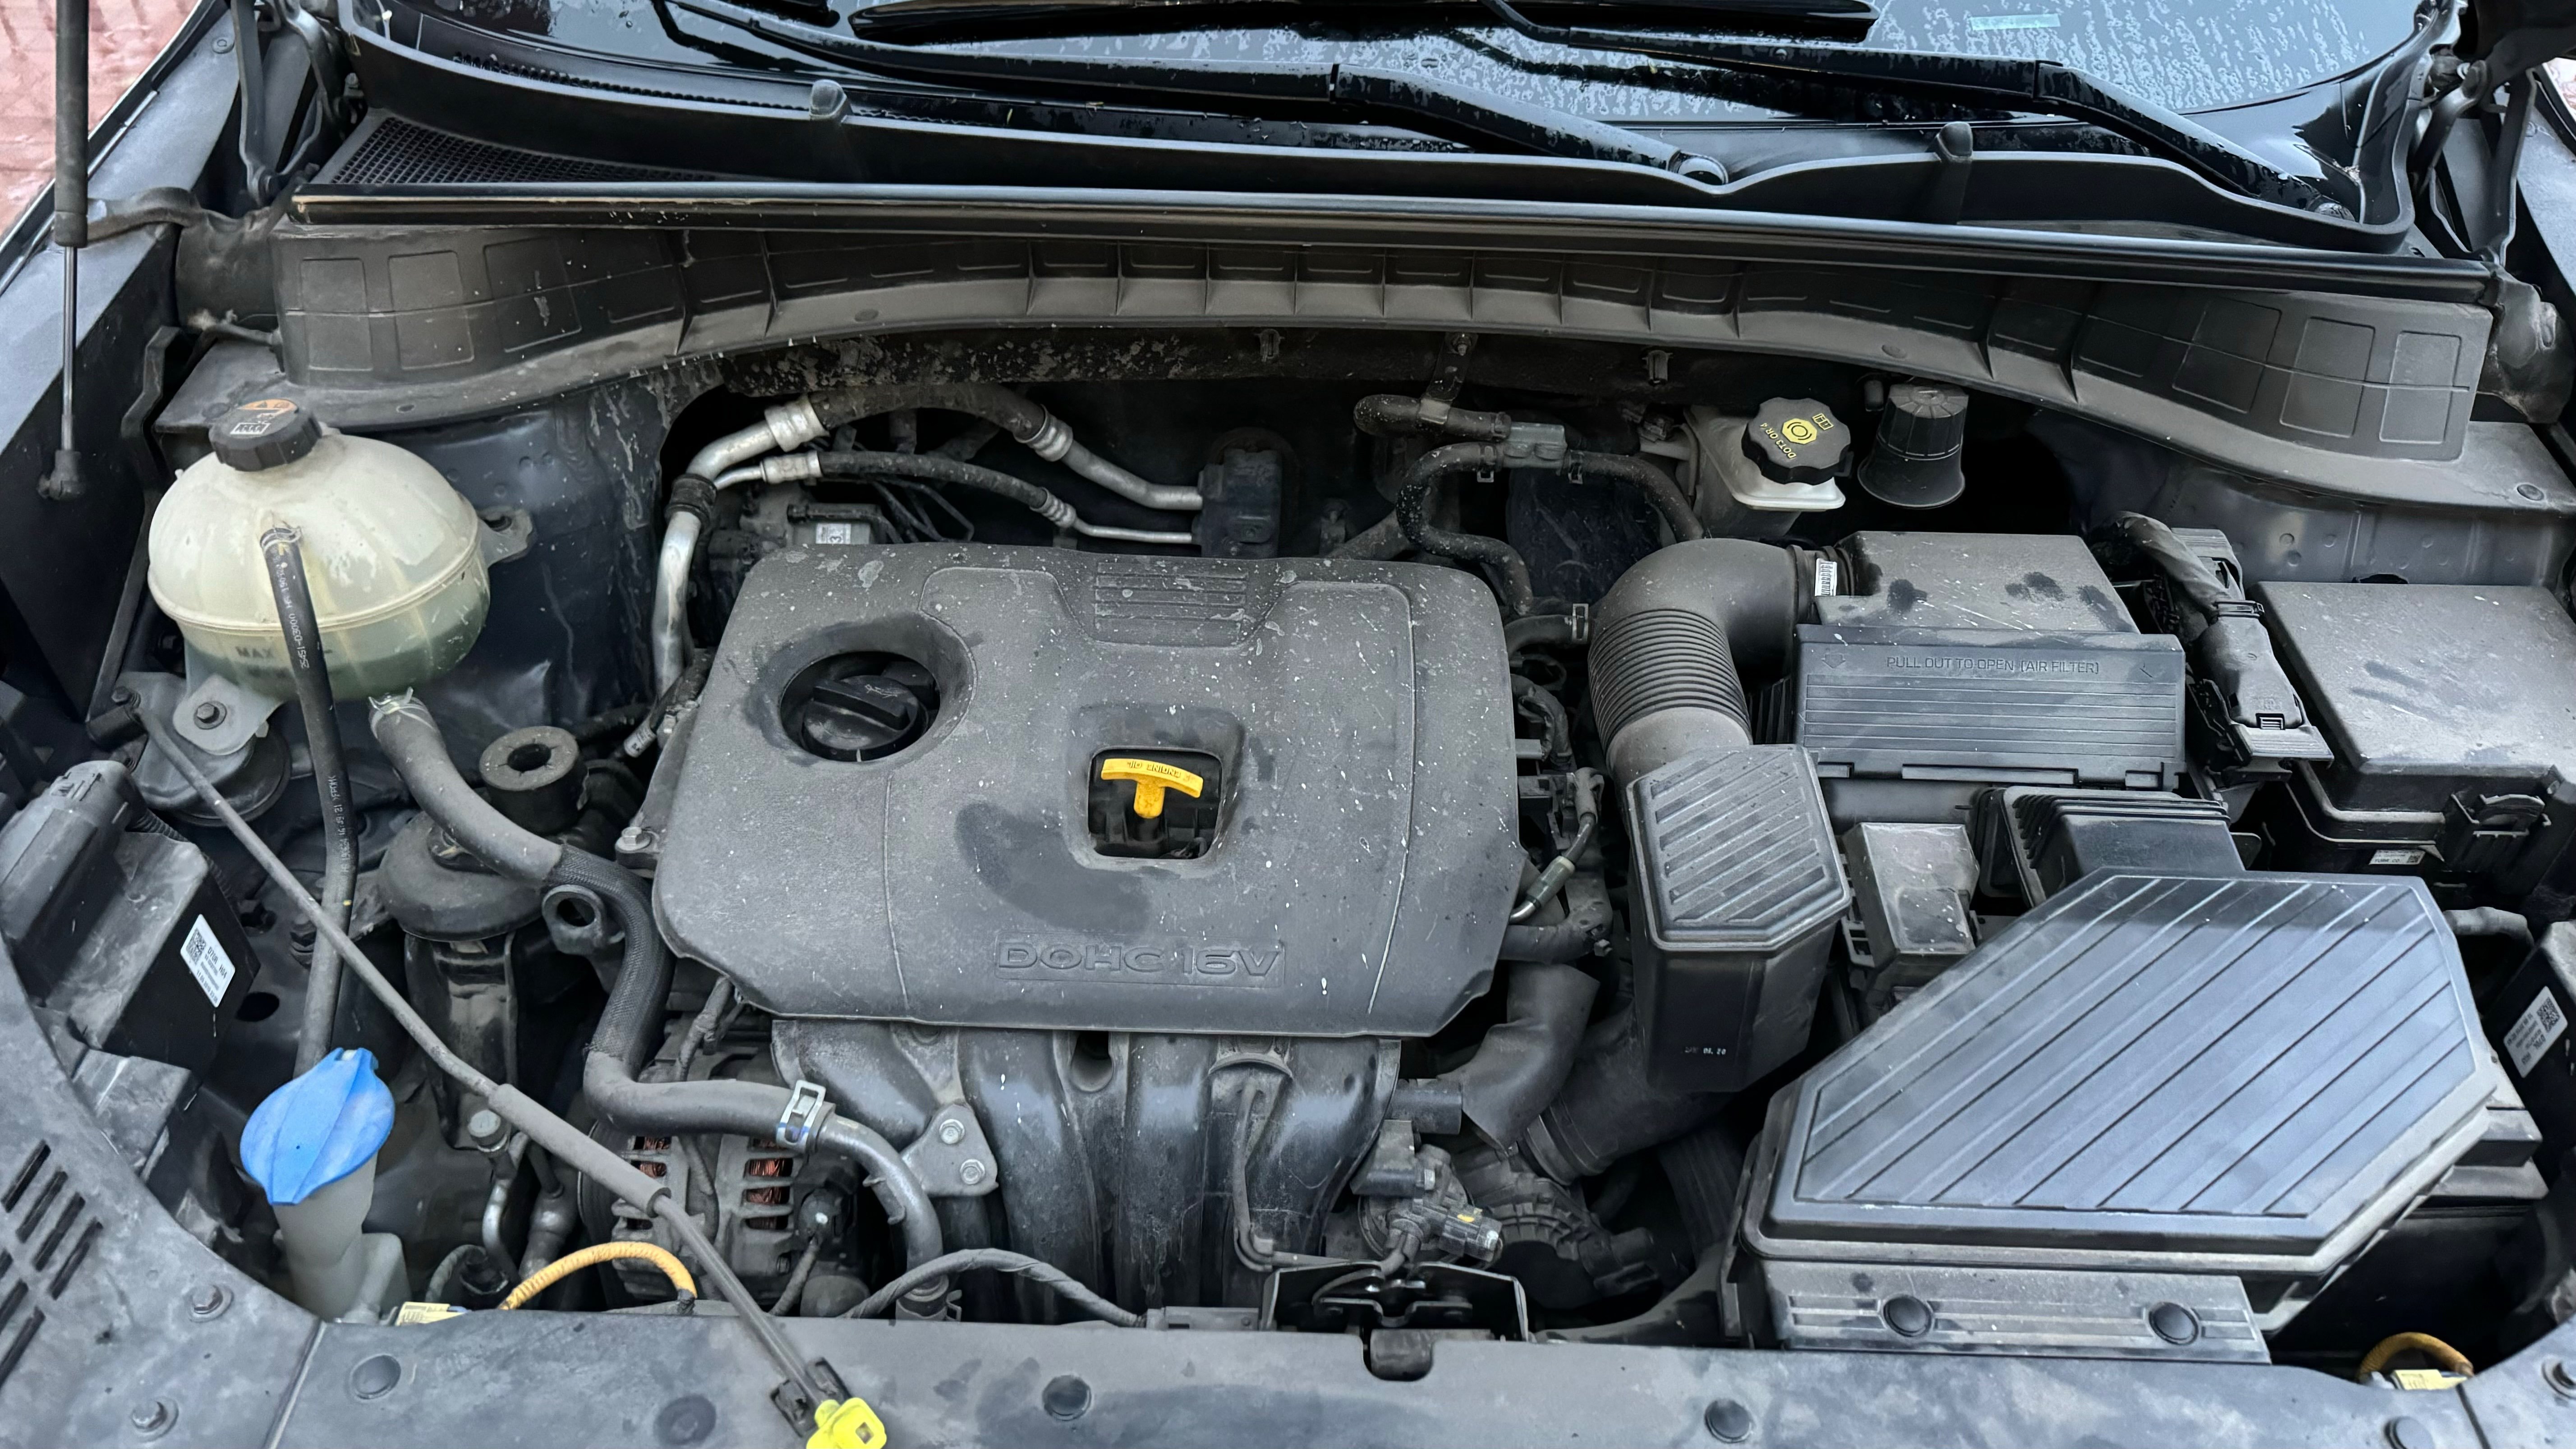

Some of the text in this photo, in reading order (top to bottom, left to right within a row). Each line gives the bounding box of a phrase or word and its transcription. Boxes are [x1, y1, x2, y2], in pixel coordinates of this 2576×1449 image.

[1766, 428, 1778, 439] OR
[1776, 440, 1797, 459] DOT3
[235, 646, 274, 658] MAX
[1887, 657, 1921, 668] PULL
[1925, 658, 1951, 668] OUT
[1956, 658, 1973, 668] TO
[1978, 659, 2014, 671] OPEN
[1127, 760, 1142, 769] OIL
[1147, 763, 1181, 778] ENGINE
[998, 942, 1280, 976] DOHC 16V
